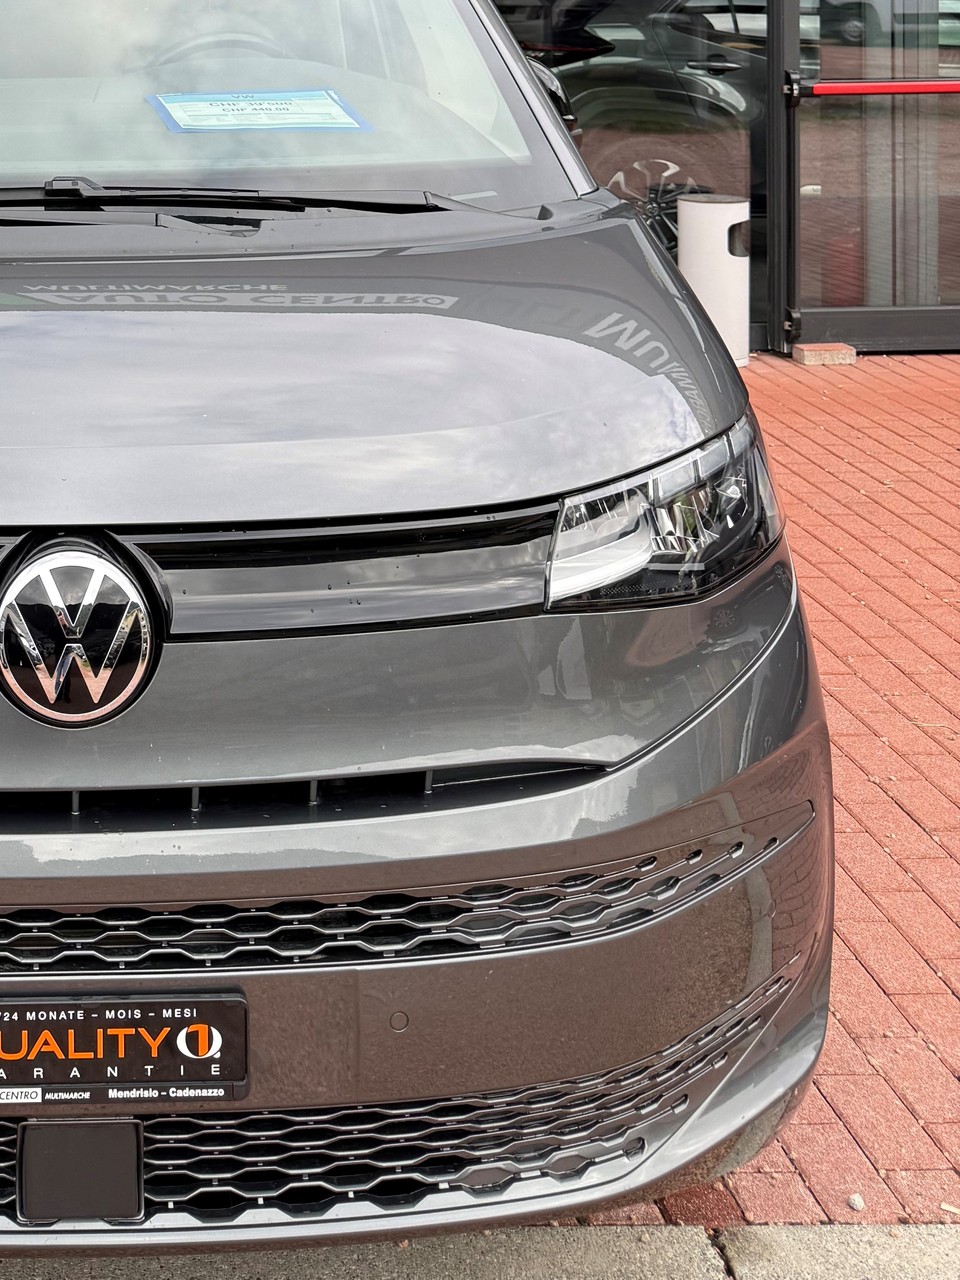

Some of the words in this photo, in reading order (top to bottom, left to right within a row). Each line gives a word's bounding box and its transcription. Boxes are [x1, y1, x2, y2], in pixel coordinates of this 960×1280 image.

[26, 1010, 85, 1021] MONATE
[105, 1008, 142, 1019] MOIS
[162, 1008, 197, 1018] MESI
[0, 1090, 38, 1100] CENTRO
[44, 1091, 91, 1100] MULTIMARCHE
[108, 1088, 159, 1098] Mendrisio
[168, 1087, 225, 1098] Cadenazzo
